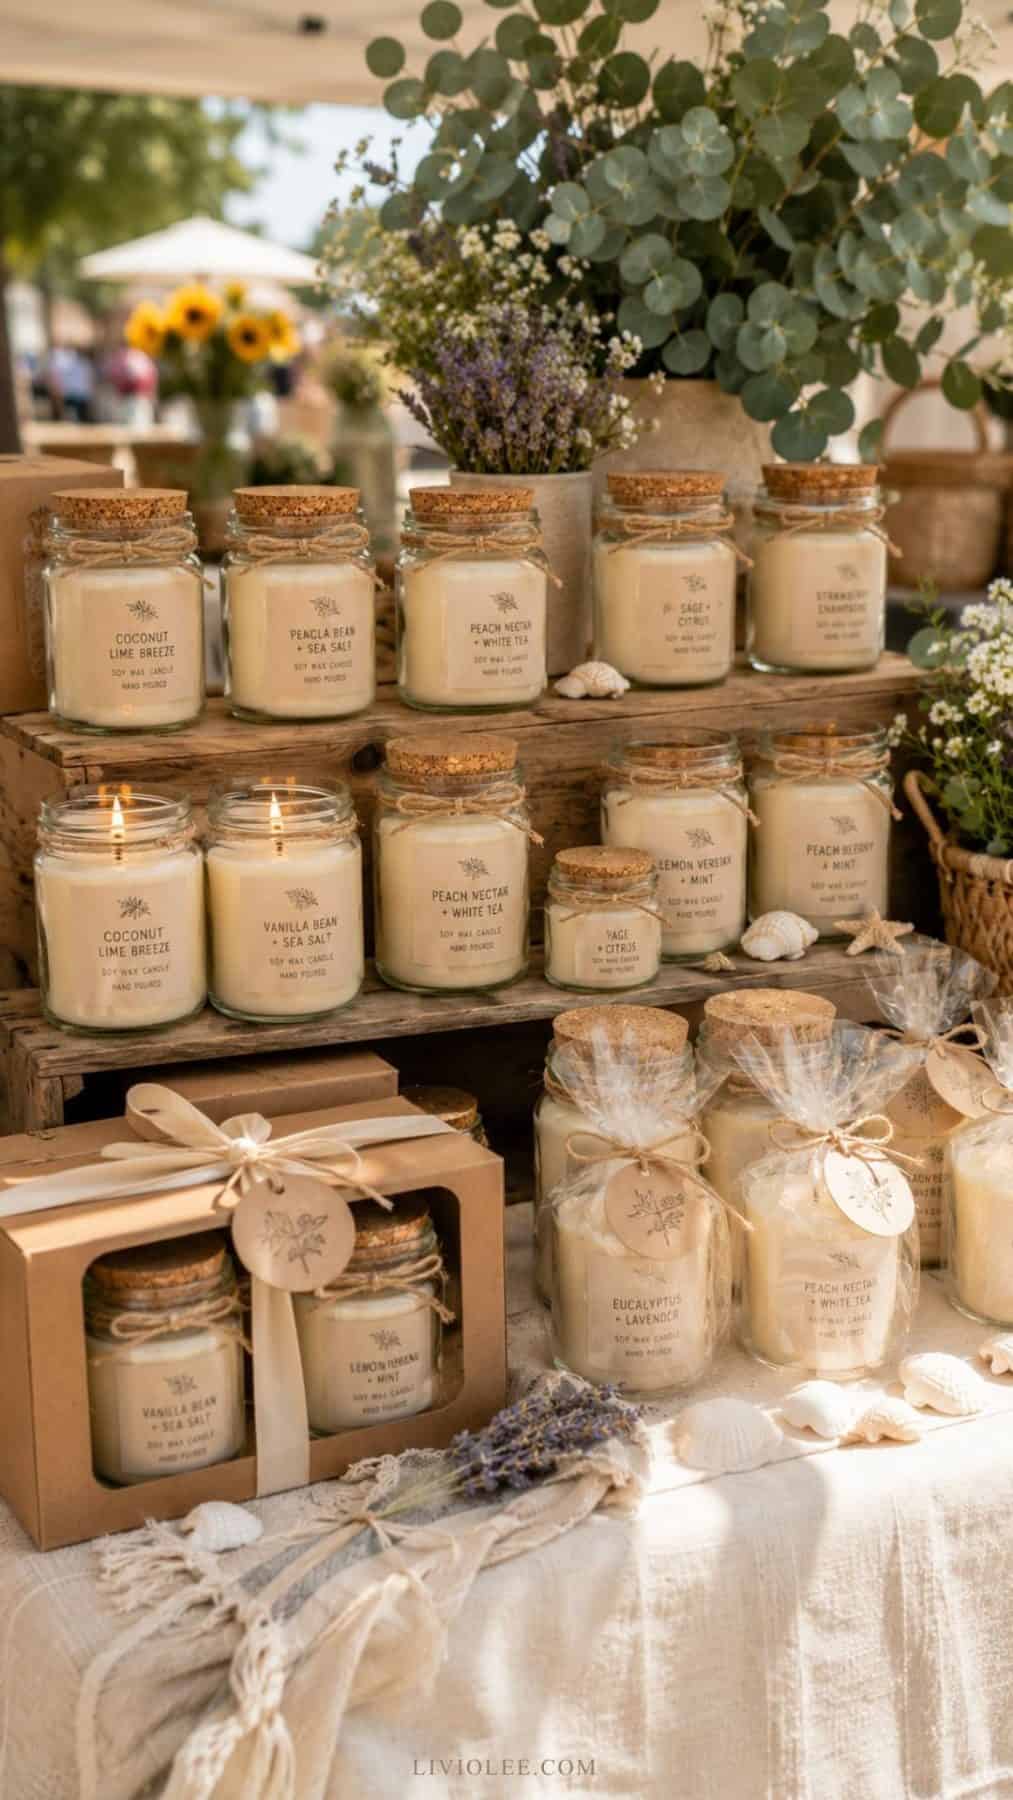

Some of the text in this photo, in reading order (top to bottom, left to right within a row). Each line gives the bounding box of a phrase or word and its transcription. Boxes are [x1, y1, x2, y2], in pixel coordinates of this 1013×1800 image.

[470, 623, 501, 634] PEACH
[115, 631, 169, 645] COCONUT
[482, 636, 513, 648] WHITE
[109, 645, 176, 659] LIME BREEZE
[307, 643, 327, 655] SEA
[657, 858, 694, 872] LEMON
[690, 874, 713, 885] MINT
[432, 889, 468, 903] PEACH
[452, 906, 483, 919] WHITE
[263, 920, 310, 933] VANILLA
[103, 926, 165, 943] COCONUT
[282, 936, 304, 948] SEA
[307, 931, 332, 946] SALT
[98, 942, 171, 958] LIME BREEZE
[804, 1281, 839, 1294] PEACH
[612, 1296, 682, 1311] EUCALYPTUS
[377, 1370, 400, 1384] MINT
[141, 1403, 188, 1417] VANILLA
[161, 1419, 183, 1433] SEA
